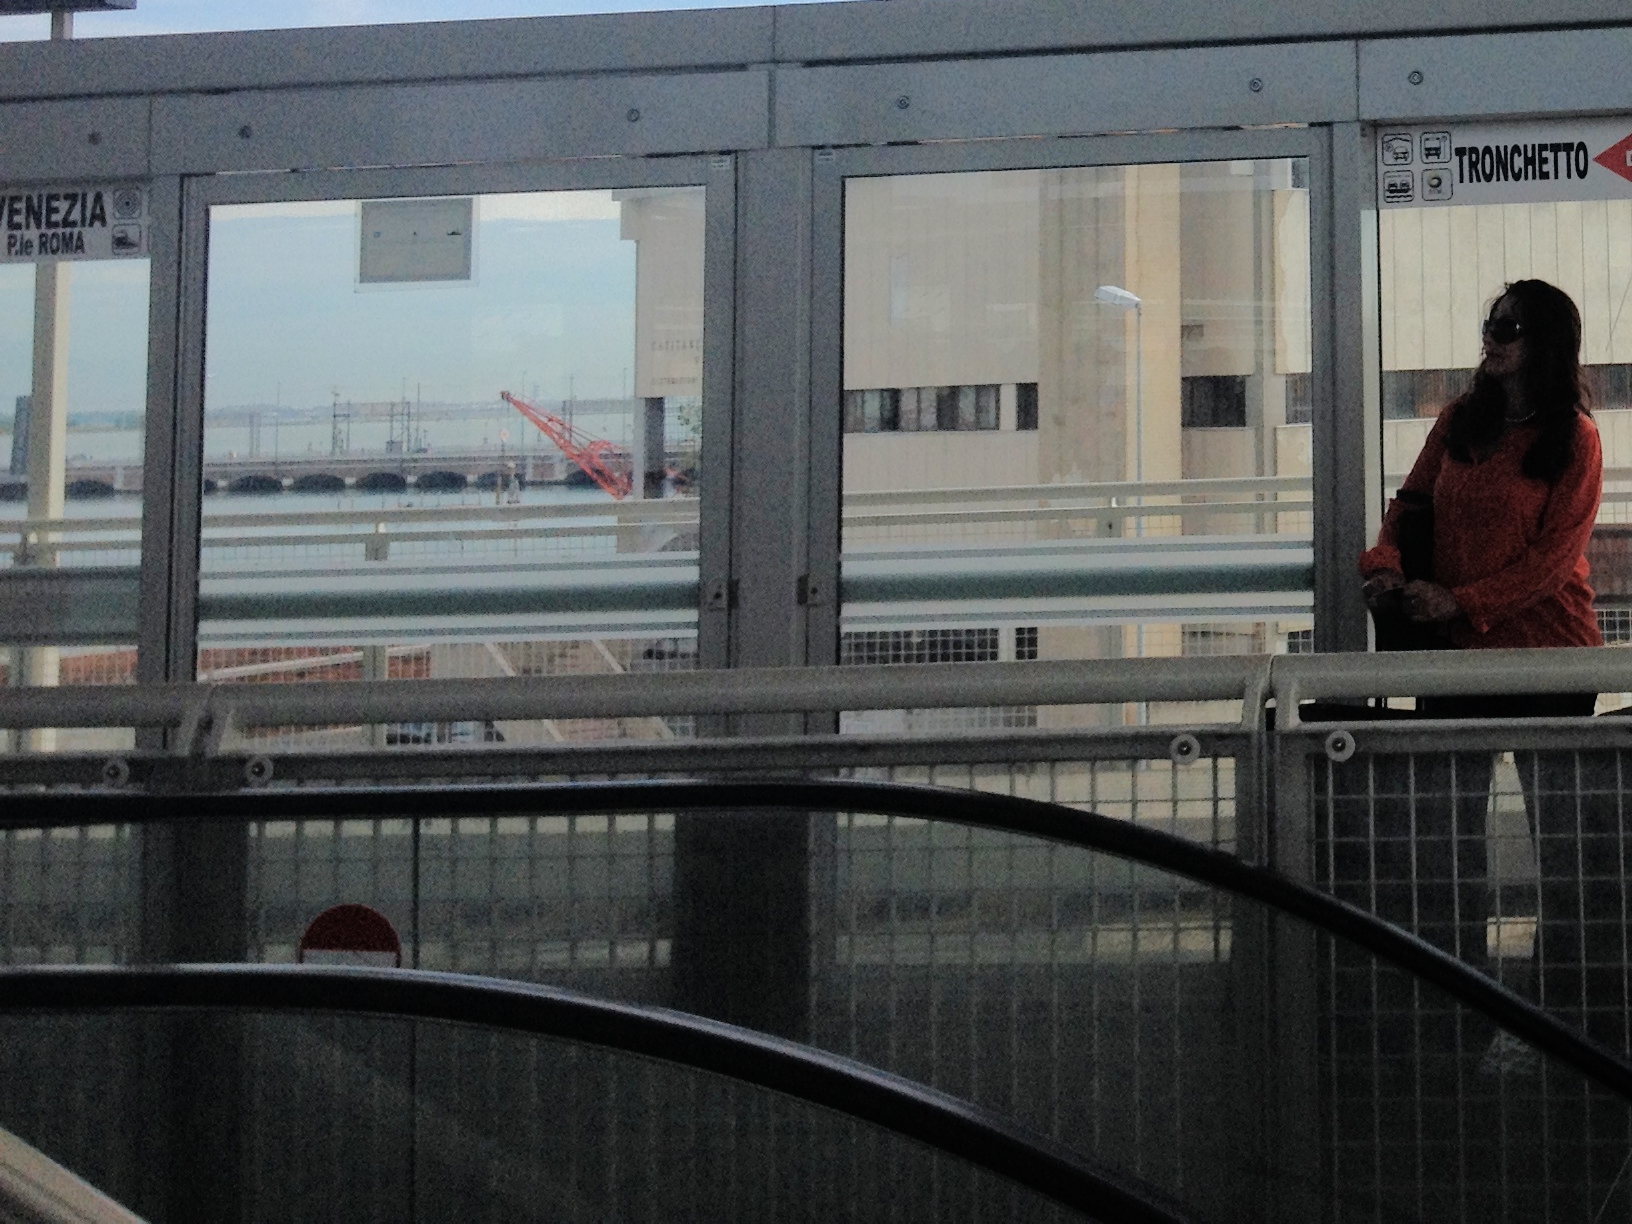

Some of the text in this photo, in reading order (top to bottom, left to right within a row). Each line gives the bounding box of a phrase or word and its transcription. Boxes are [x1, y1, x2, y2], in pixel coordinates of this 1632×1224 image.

[1455, 141, 1589, 183] TRONCHETTO
[7, 230, 86, 256] P.le ROMA
